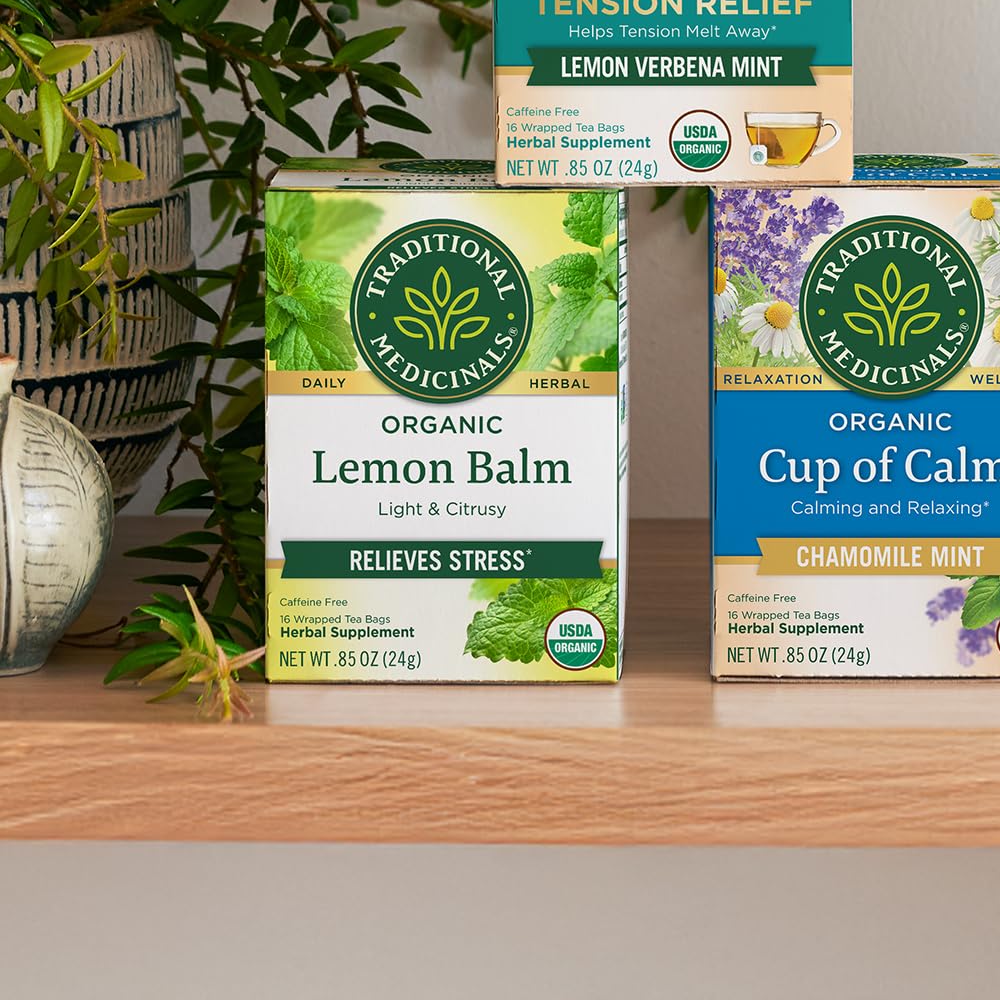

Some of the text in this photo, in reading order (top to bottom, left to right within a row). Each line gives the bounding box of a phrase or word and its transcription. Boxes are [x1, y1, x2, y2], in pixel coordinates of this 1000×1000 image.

[569, 24, 614, 40] Helps
[619, 25, 680, 39] Tension
[686, 24, 720, 39] Melt
[561, 56, 782, 78] LEMON VERBENA MINT
[506, 107, 579, 117] Caffeine Free
[506, 123, 625, 134] 16 Wrapped Tea Bags
[683, 125, 717, 139] USDA
[507, 136, 651, 151] Herbal Supplement
[679, 143, 722, 155] ORGANIC
[507, 160, 533, 176] NET
[537, 160, 559, 176] WT
[565, 160, 587, 176] .85
[593, 160, 612, 176] OZ
[618, 159, 658, 180] (24g)
[366, 234, 516, 301] TRADITIONAL
[815, 230, 967, 296] TRADITIONAL
[302, 378, 346, 388] DAILY
[530, 378, 590, 389] HERBAL
[723, 374, 823, 385] RELAXATION
[381, 415, 503, 434] ORGANIC
[829, 412, 952, 432] ORGANIC
[313, 448, 572, 485] Lemon Balm
[759, 448, 840, 494] Cup
[853, 446, 897, 483] of
[379, 502, 507, 519] Light & Citrusy
[791, 501, 862, 517] Calming
[869, 501, 901, 515] and
[350, 549, 441, 571] RELIEVES
[797, 546, 985, 567] CHAMOMILE MINT
[280, 597, 348, 607] Caffeine Free
[727, 593, 796, 603] Caffeine Free
[280, 626, 414, 640] Herbal Supplement
[728, 622, 864, 636] Herbal Supplement
[727, 647, 870, 666] NET WT .85 OZ (24g)
